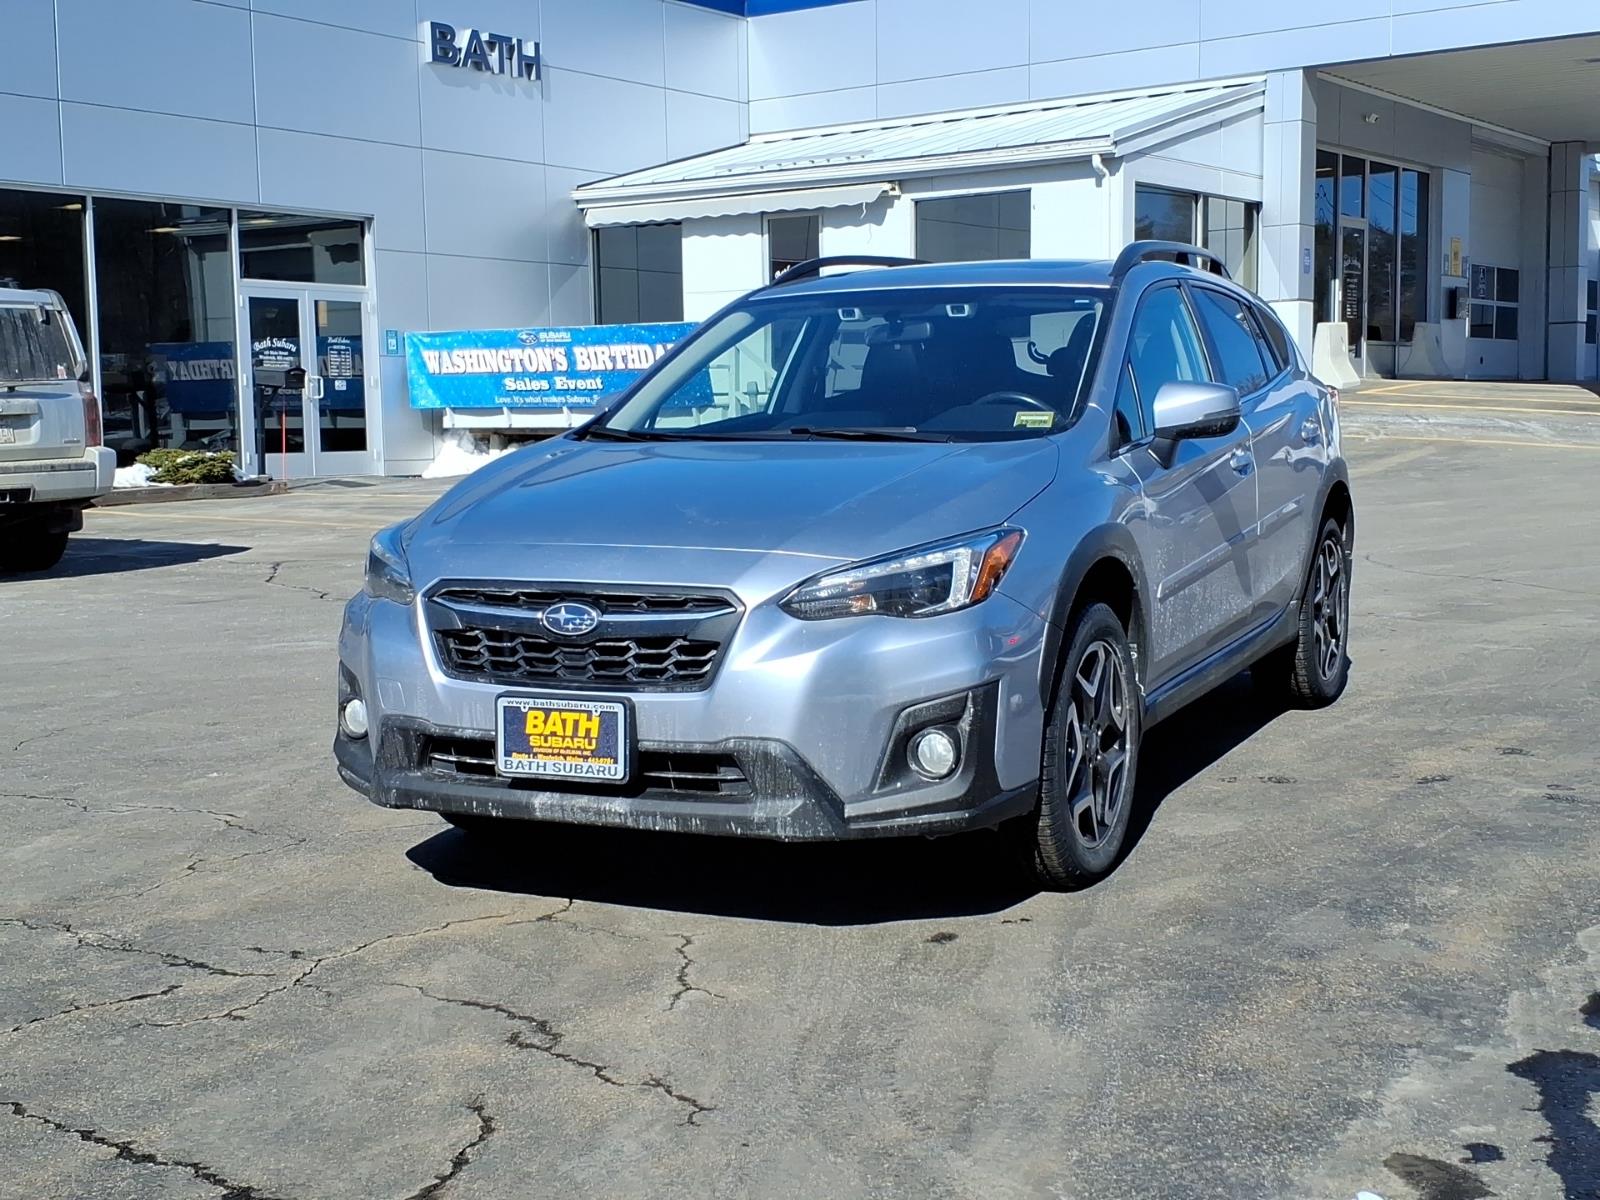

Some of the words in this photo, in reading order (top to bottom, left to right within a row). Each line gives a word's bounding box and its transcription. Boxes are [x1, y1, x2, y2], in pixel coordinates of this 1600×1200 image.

[427, 20, 541, 81] BATH
[253, 336, 272, 351] Bath
[272, 337, 297, 353] Subaru
[422, 346, 569, 375] WASHINGTON'S
[574, 343, 674, 372] BIRTHDA
[504, 377, 550, 391] Sales
[555, 376, 603, 390] Event
[525, 395, 541, 403] what
[543, 395, 565, 403] makes
[507, 699, 615, 711] www.bathsubaru.com
[525, 710, 600, 738] BATH
[529, 735, 596, 750] SUBARU
[504, 759, 547, 772] BATH
[552, 761, 618, 777] SUBARU
